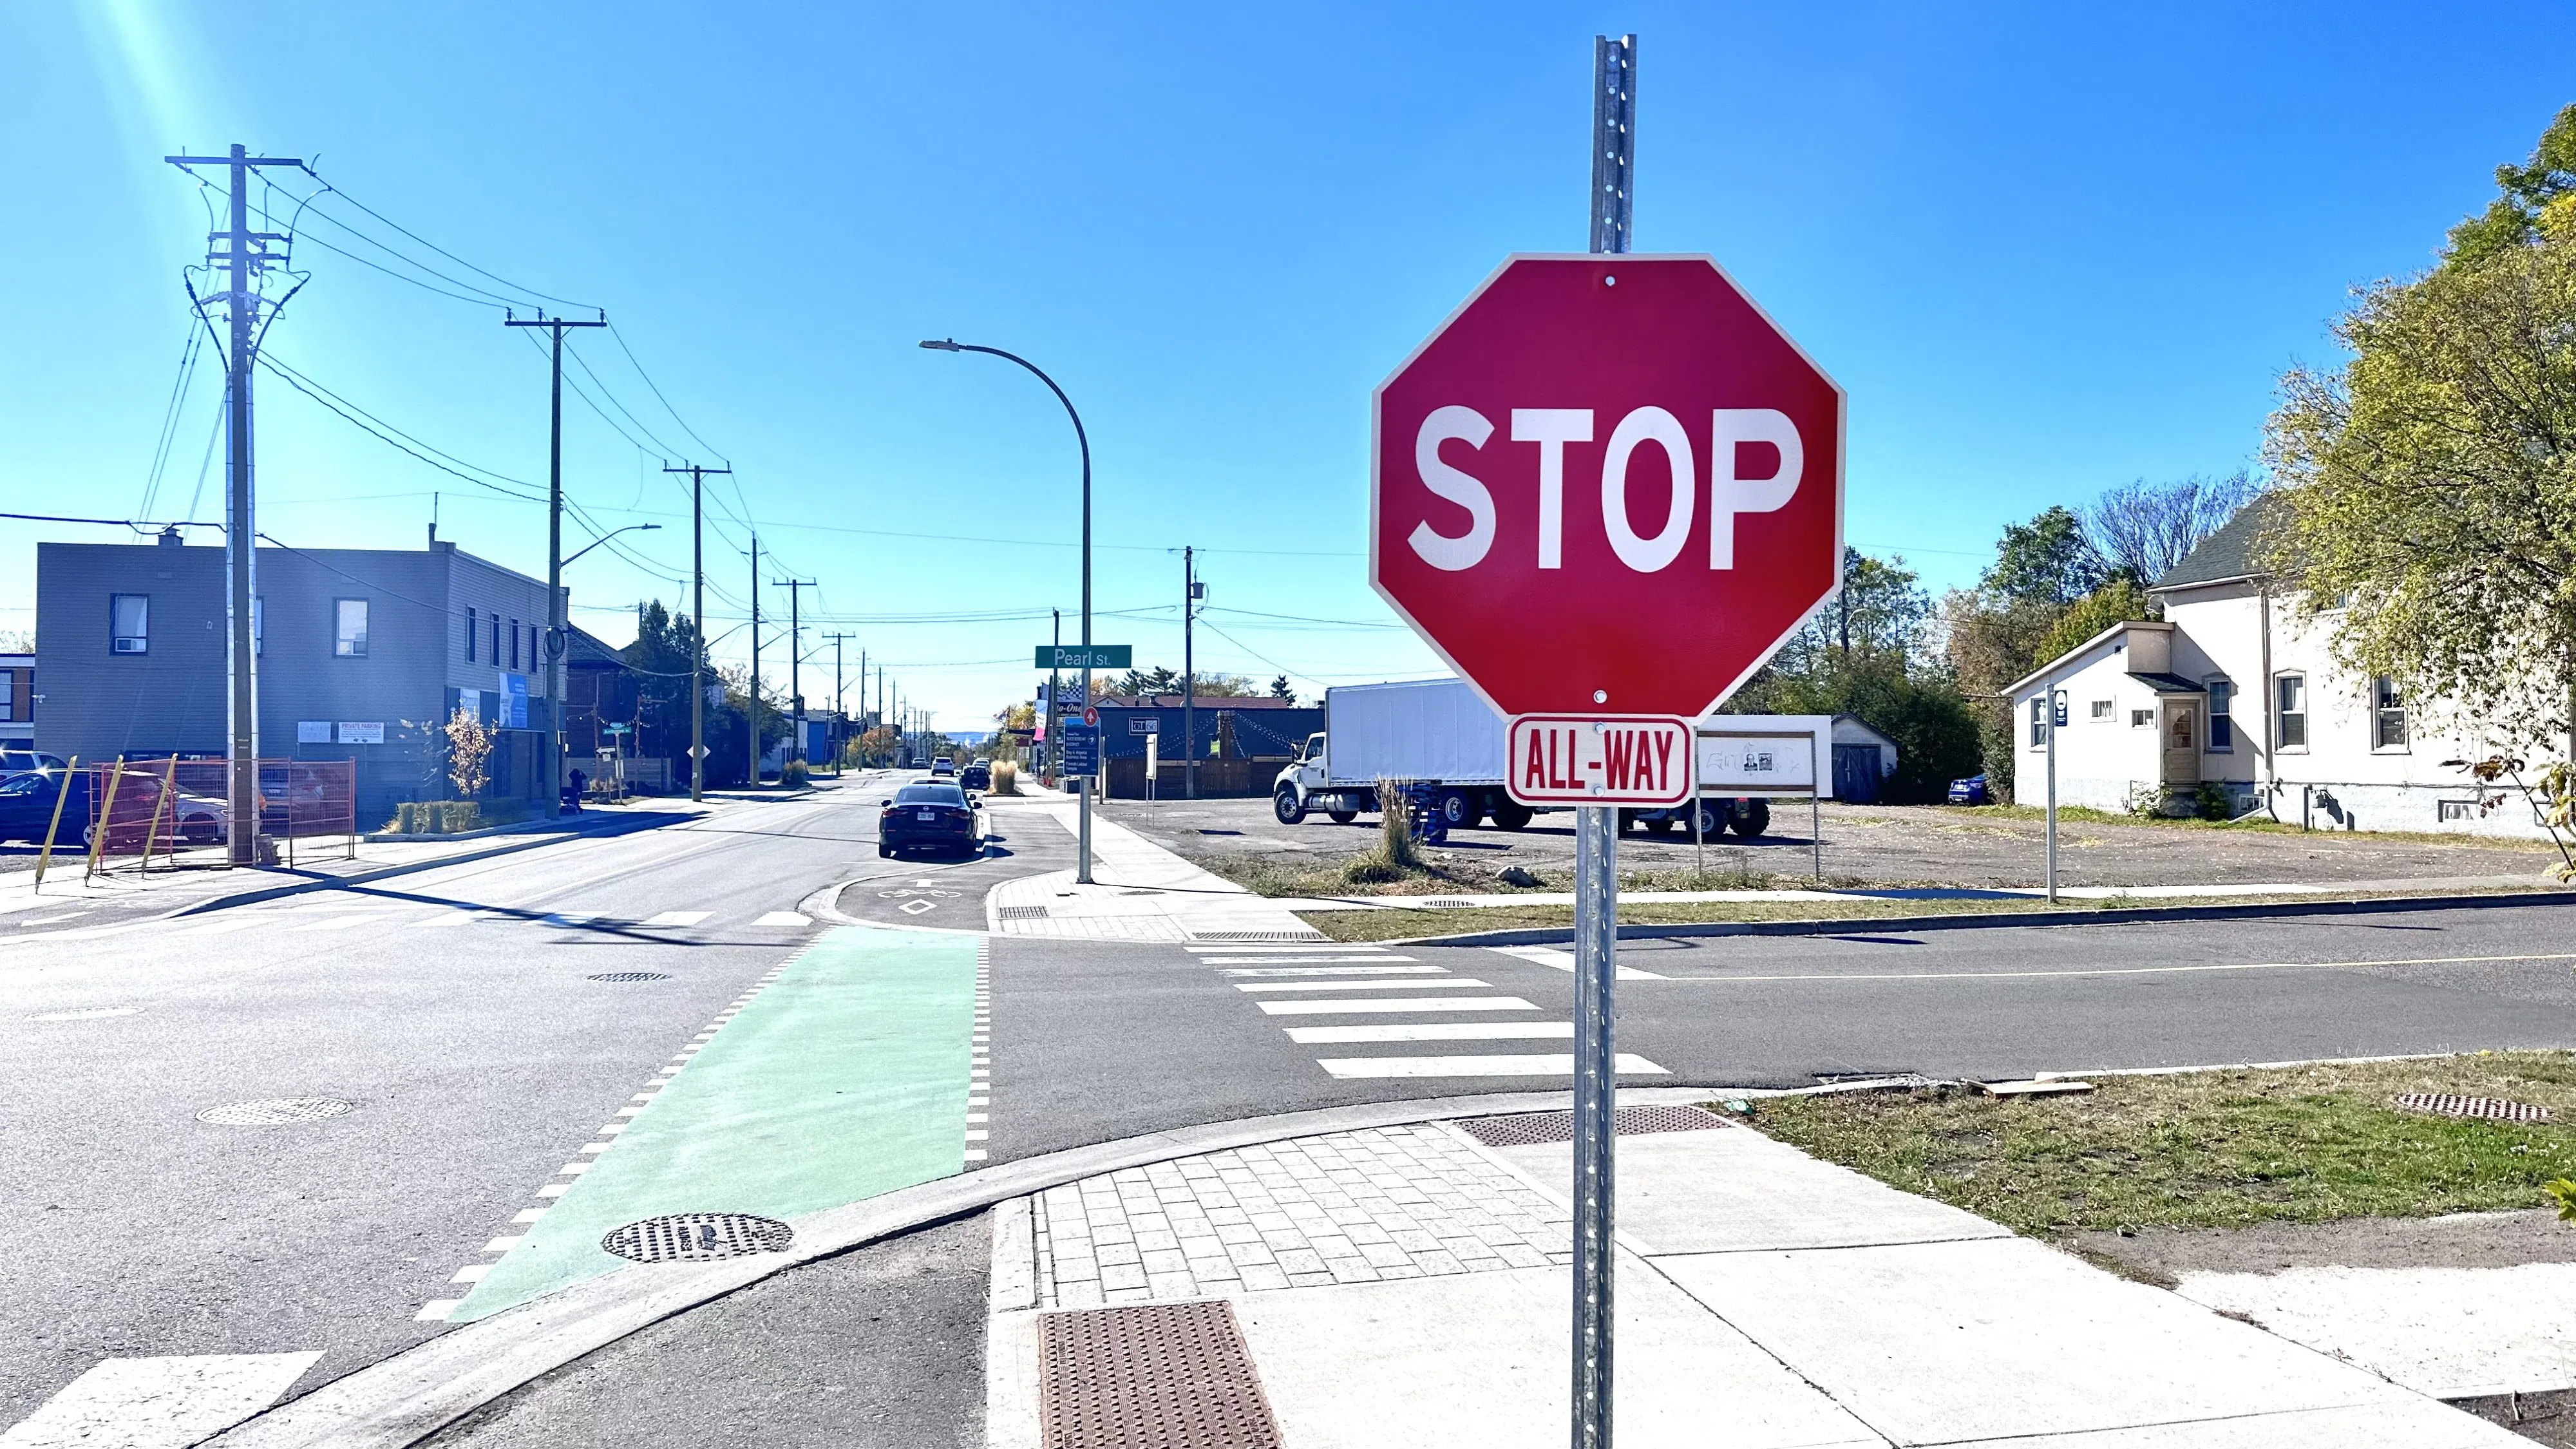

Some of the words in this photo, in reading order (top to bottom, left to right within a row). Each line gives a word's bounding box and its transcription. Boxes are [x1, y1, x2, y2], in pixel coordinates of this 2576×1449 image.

[1407, 405, 1803, 573] STOP
[1054, 649, 1092, 665] Pearl
[1096, 654, 1111, 665] St.
[1146, 721, 1157, 731] 66
[1525, 728, 1674, 791] ALL-WAY
